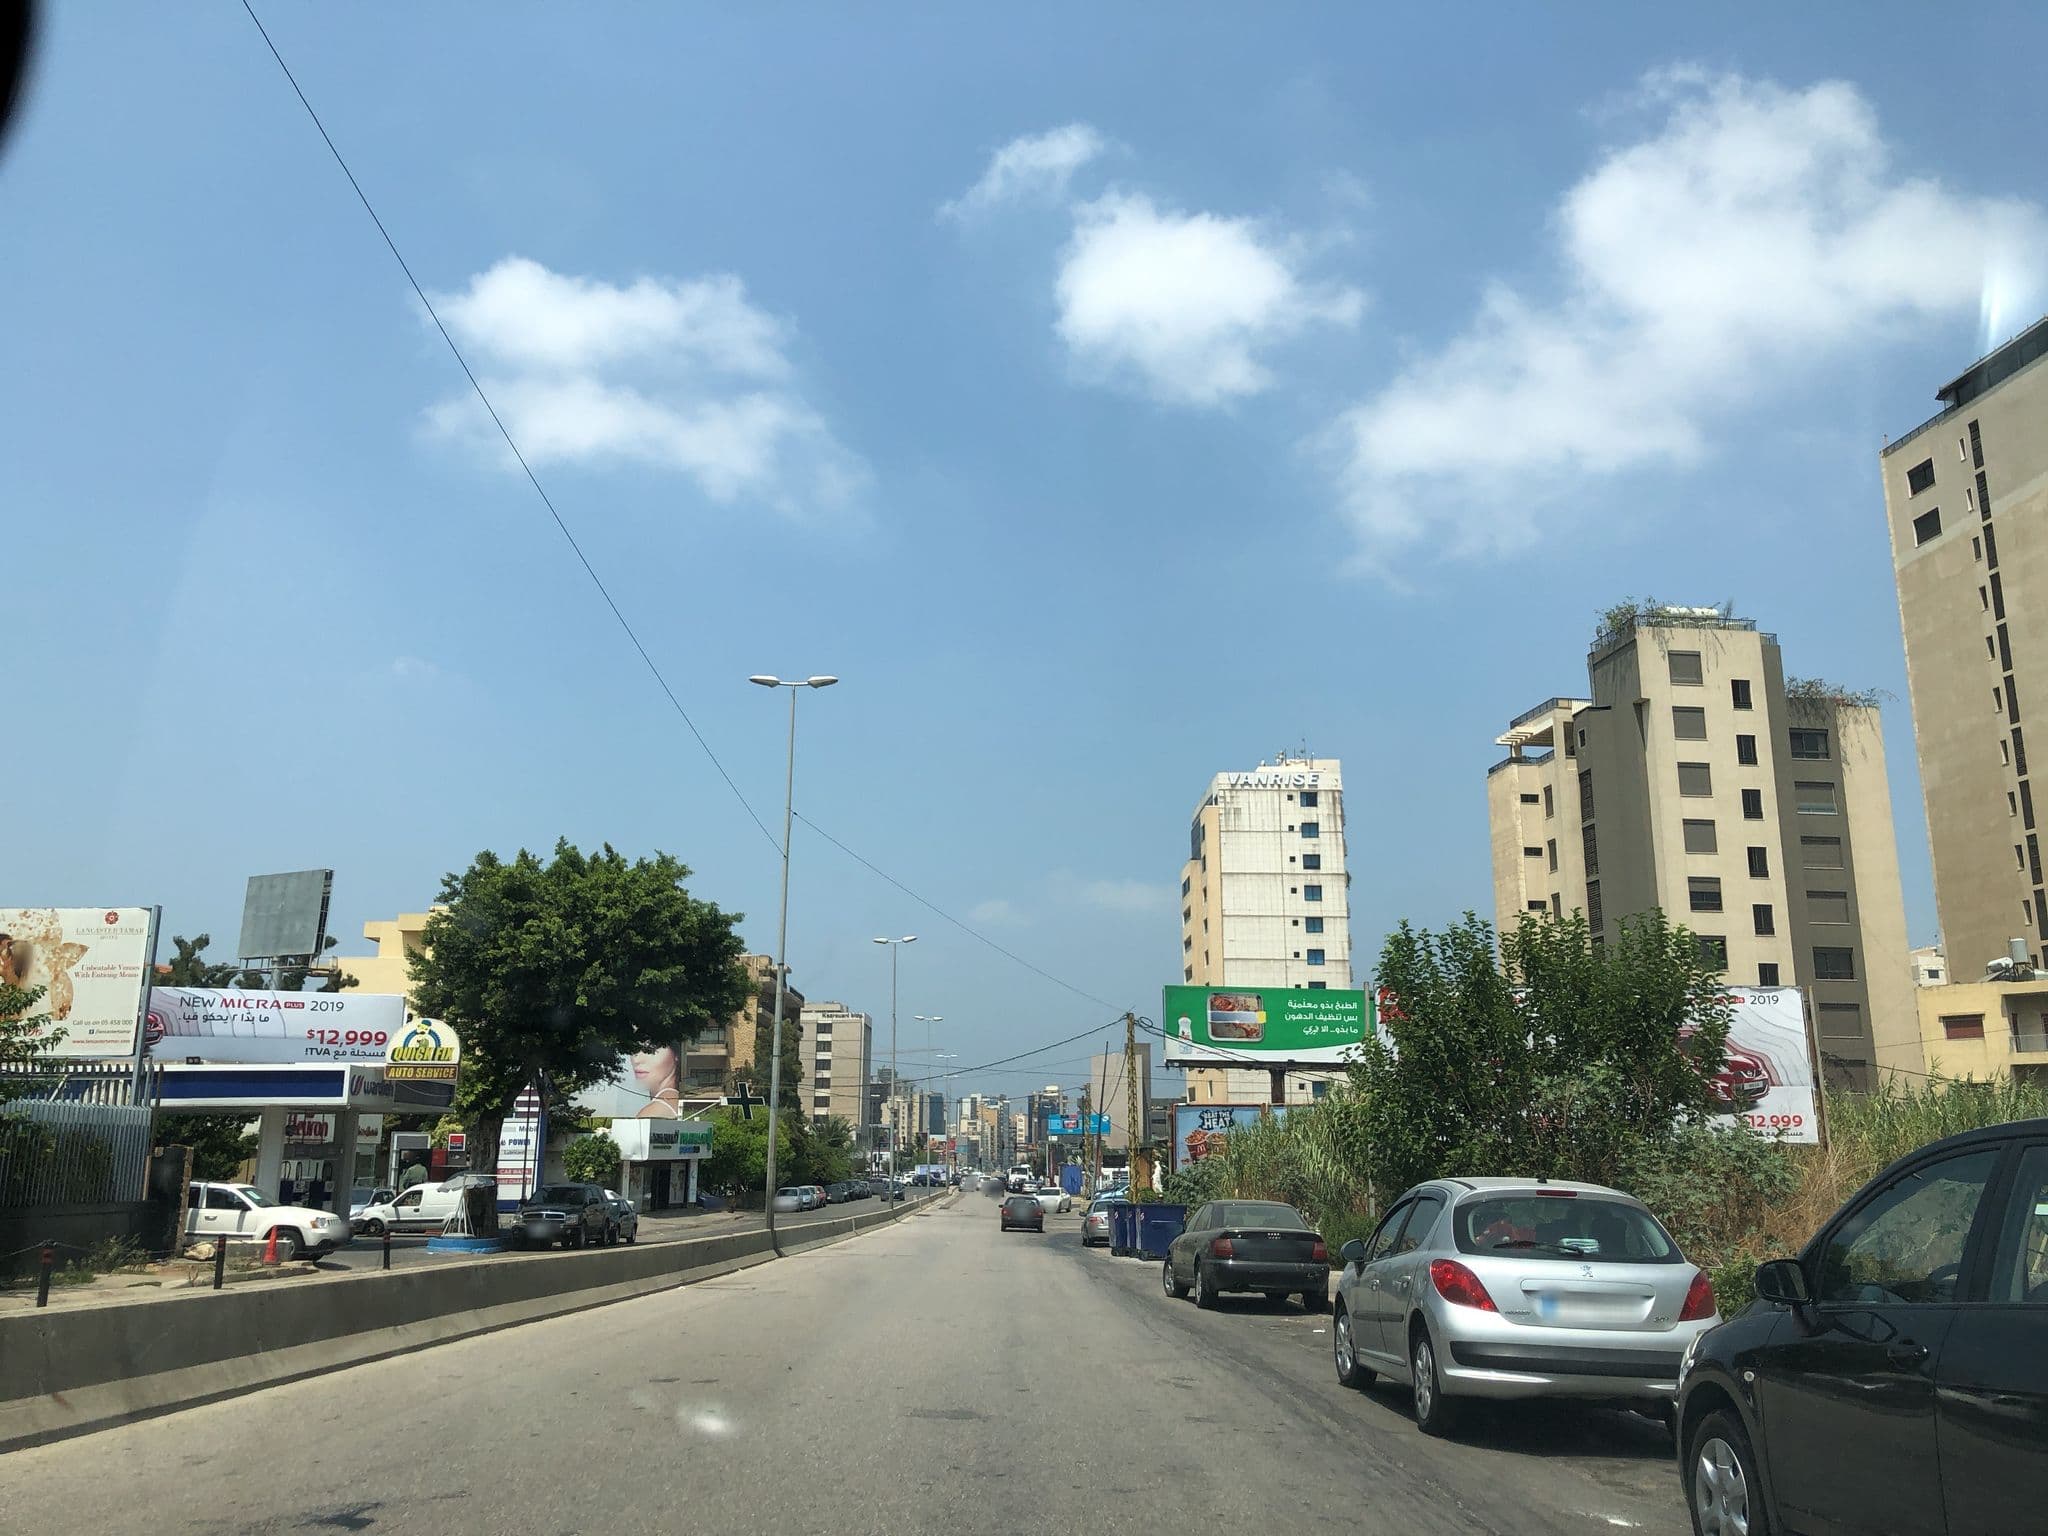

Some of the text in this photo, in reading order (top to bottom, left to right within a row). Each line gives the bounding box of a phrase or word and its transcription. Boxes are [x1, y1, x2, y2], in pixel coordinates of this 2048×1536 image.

[1228, 772, 1320, 787] VANRISE
[180, 996, 345, 1012] NEW MICRA PLUS 2019
[1750, 995, 1779, 1005] 2019
[259, 1014, 270, 1023] ما
[306, 1028, 388, 1048] $12,999
[333, 1049, 347, 1060] مع
[350, 1048, 387, 1058] مسجلة
[391, 1046, 455, 1062] QUICK FIX
[389, 1067, 456, 1079] AUTO SERVICE
